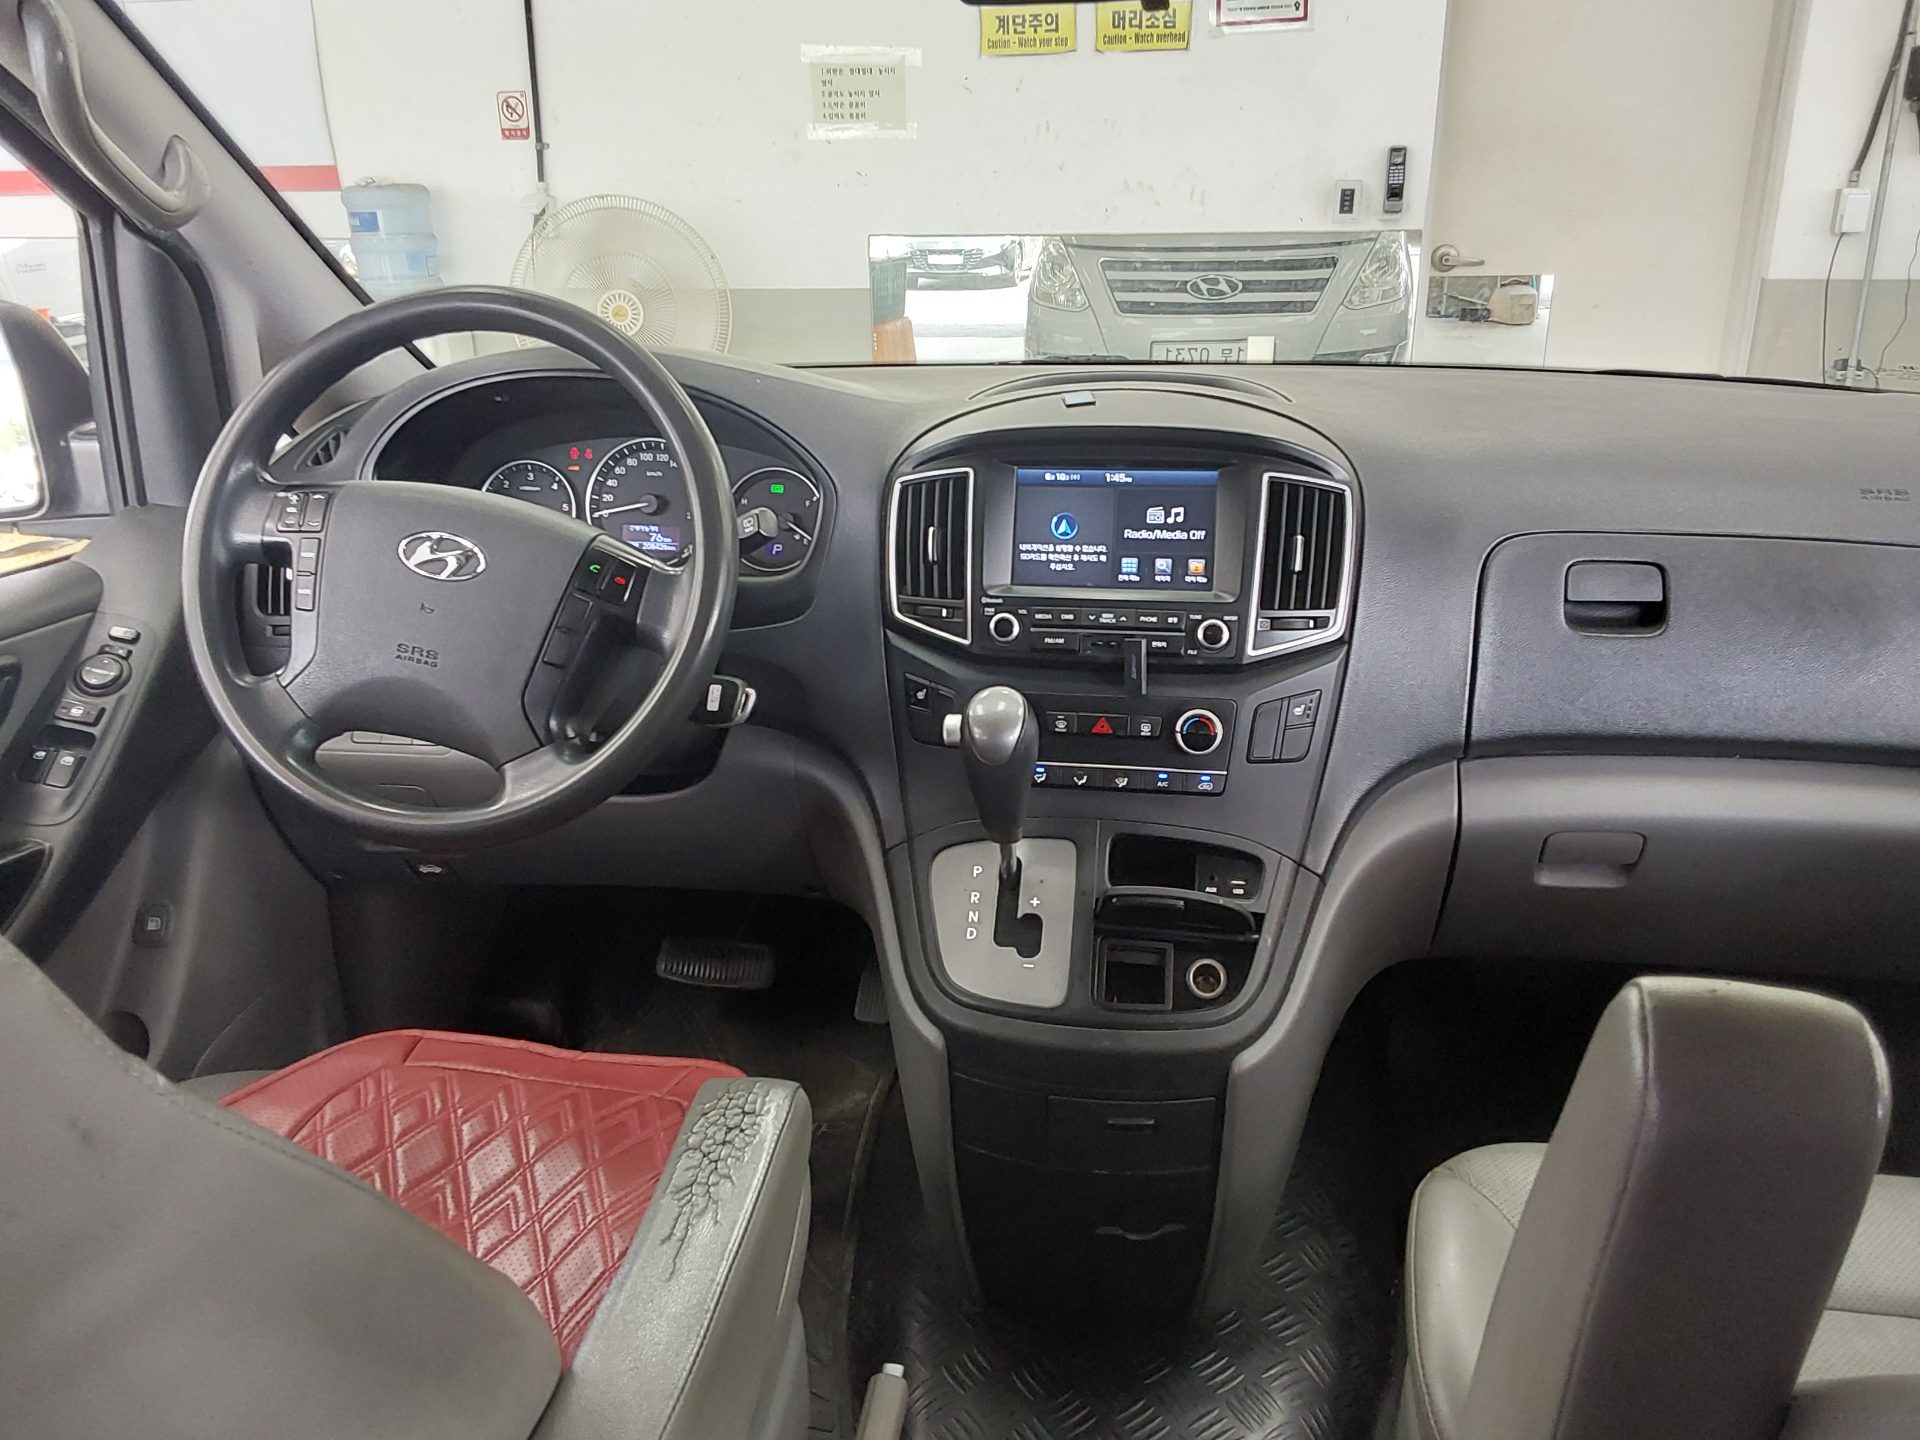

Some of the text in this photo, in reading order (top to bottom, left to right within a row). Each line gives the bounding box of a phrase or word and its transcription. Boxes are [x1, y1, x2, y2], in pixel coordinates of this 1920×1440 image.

[995, 13, 1060, 35] 계단주의
[987, 37, 1011, 50] Caution
[1017, 36, 1038, 49] Watch
[1038, 37, 1053, 48] your
[1054, 36, 1069, 48] step
[1103, 33, 1127, 46] Caution
[1134, 32, 1154, 45] Watch
[1155, 31, 1186, 44] overhead
[626, 457, 638, 467] 80
[639, 452, 654, 462] 100
[656, 453, 670, 462] 120
[526, 472, 535, 481] 3
[614, 466, 626, 475] 60
[502, 480, 510, 489] 2
[551, 482, 559, 490] 4
[606, 478, 619, 488] 40
[601, 494, 614, 502] 20
[561, 503, 570, 512] 5
[1123, 528, 1207, 540] Radio/Media Off
[772, 543, 783, 555] P
[396, 642, 440, 661] SRS
[394, 653, 439, 668] AIRBAG
[972, 865, 983, 878] P
[970, 891, 981, 904] R
[967, 910, 979, 923] N
[966, 927, 977, 940] D
